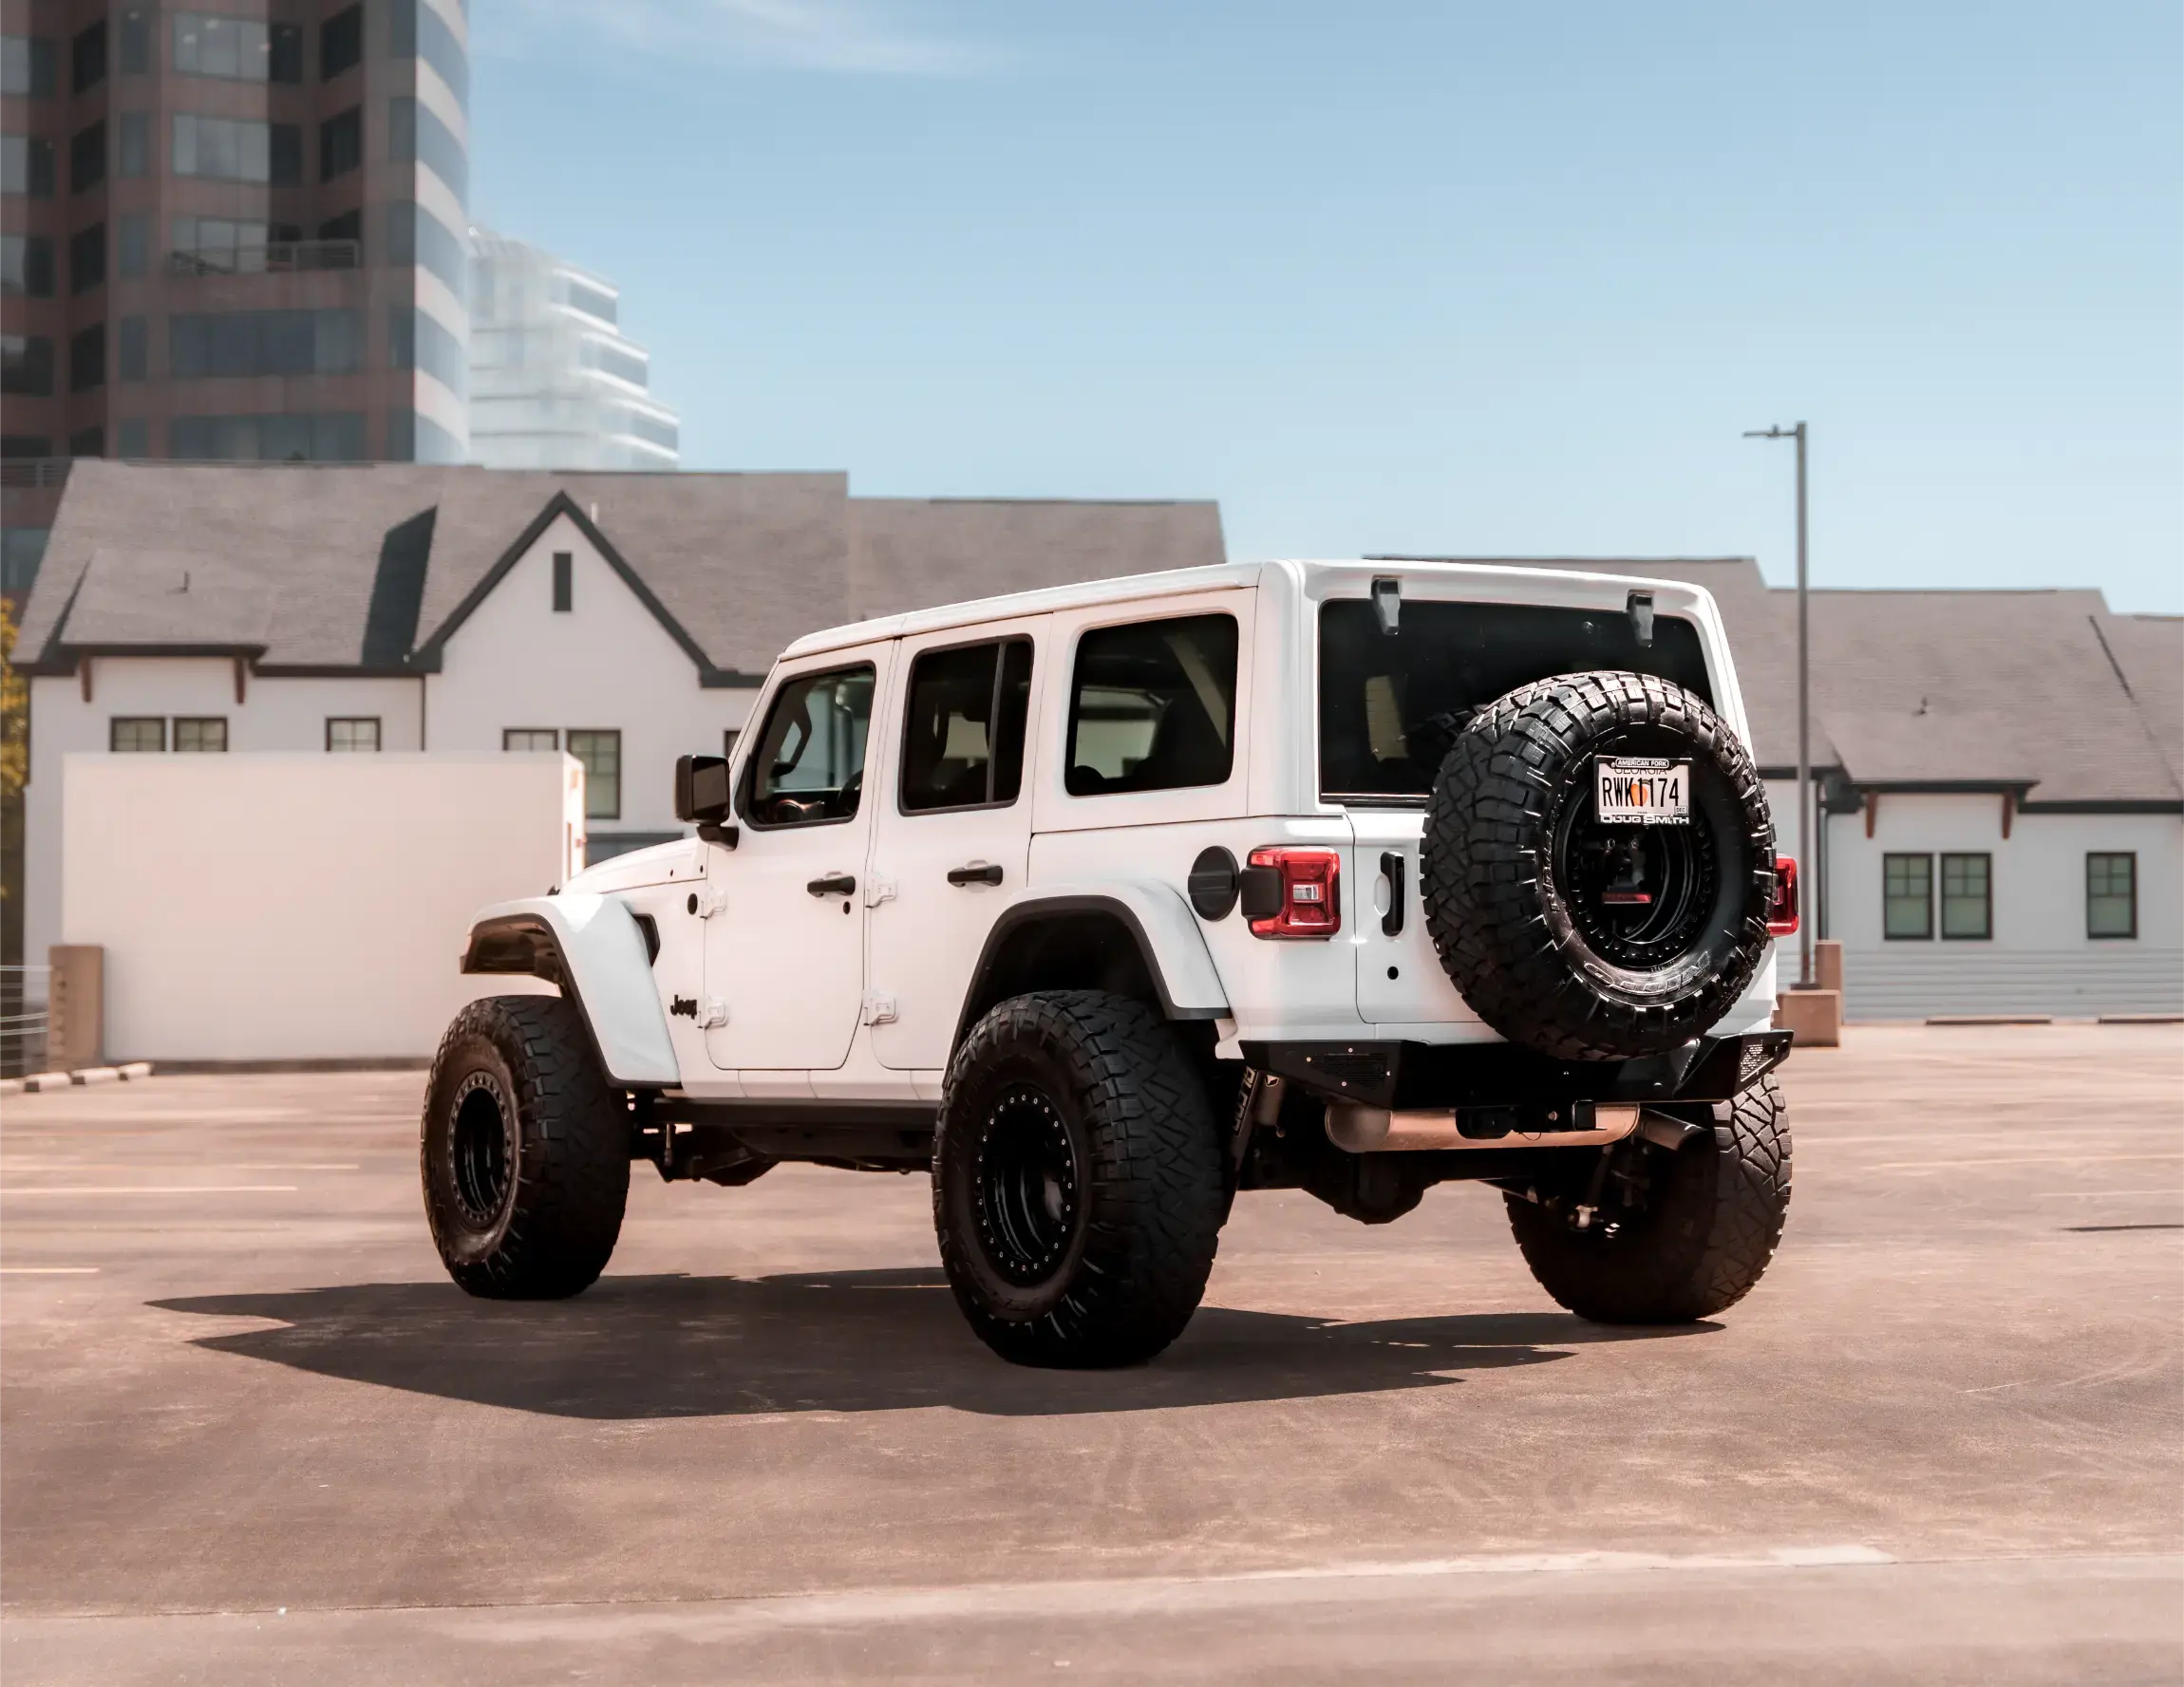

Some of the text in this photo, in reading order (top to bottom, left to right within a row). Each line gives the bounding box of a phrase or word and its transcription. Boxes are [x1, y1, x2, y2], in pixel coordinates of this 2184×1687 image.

[1602, 777, 1679, 807] RWK1174
[1600, 815, 1690, 824] DOUG SMITH
[670, 995, 697, 1021] Jeep
